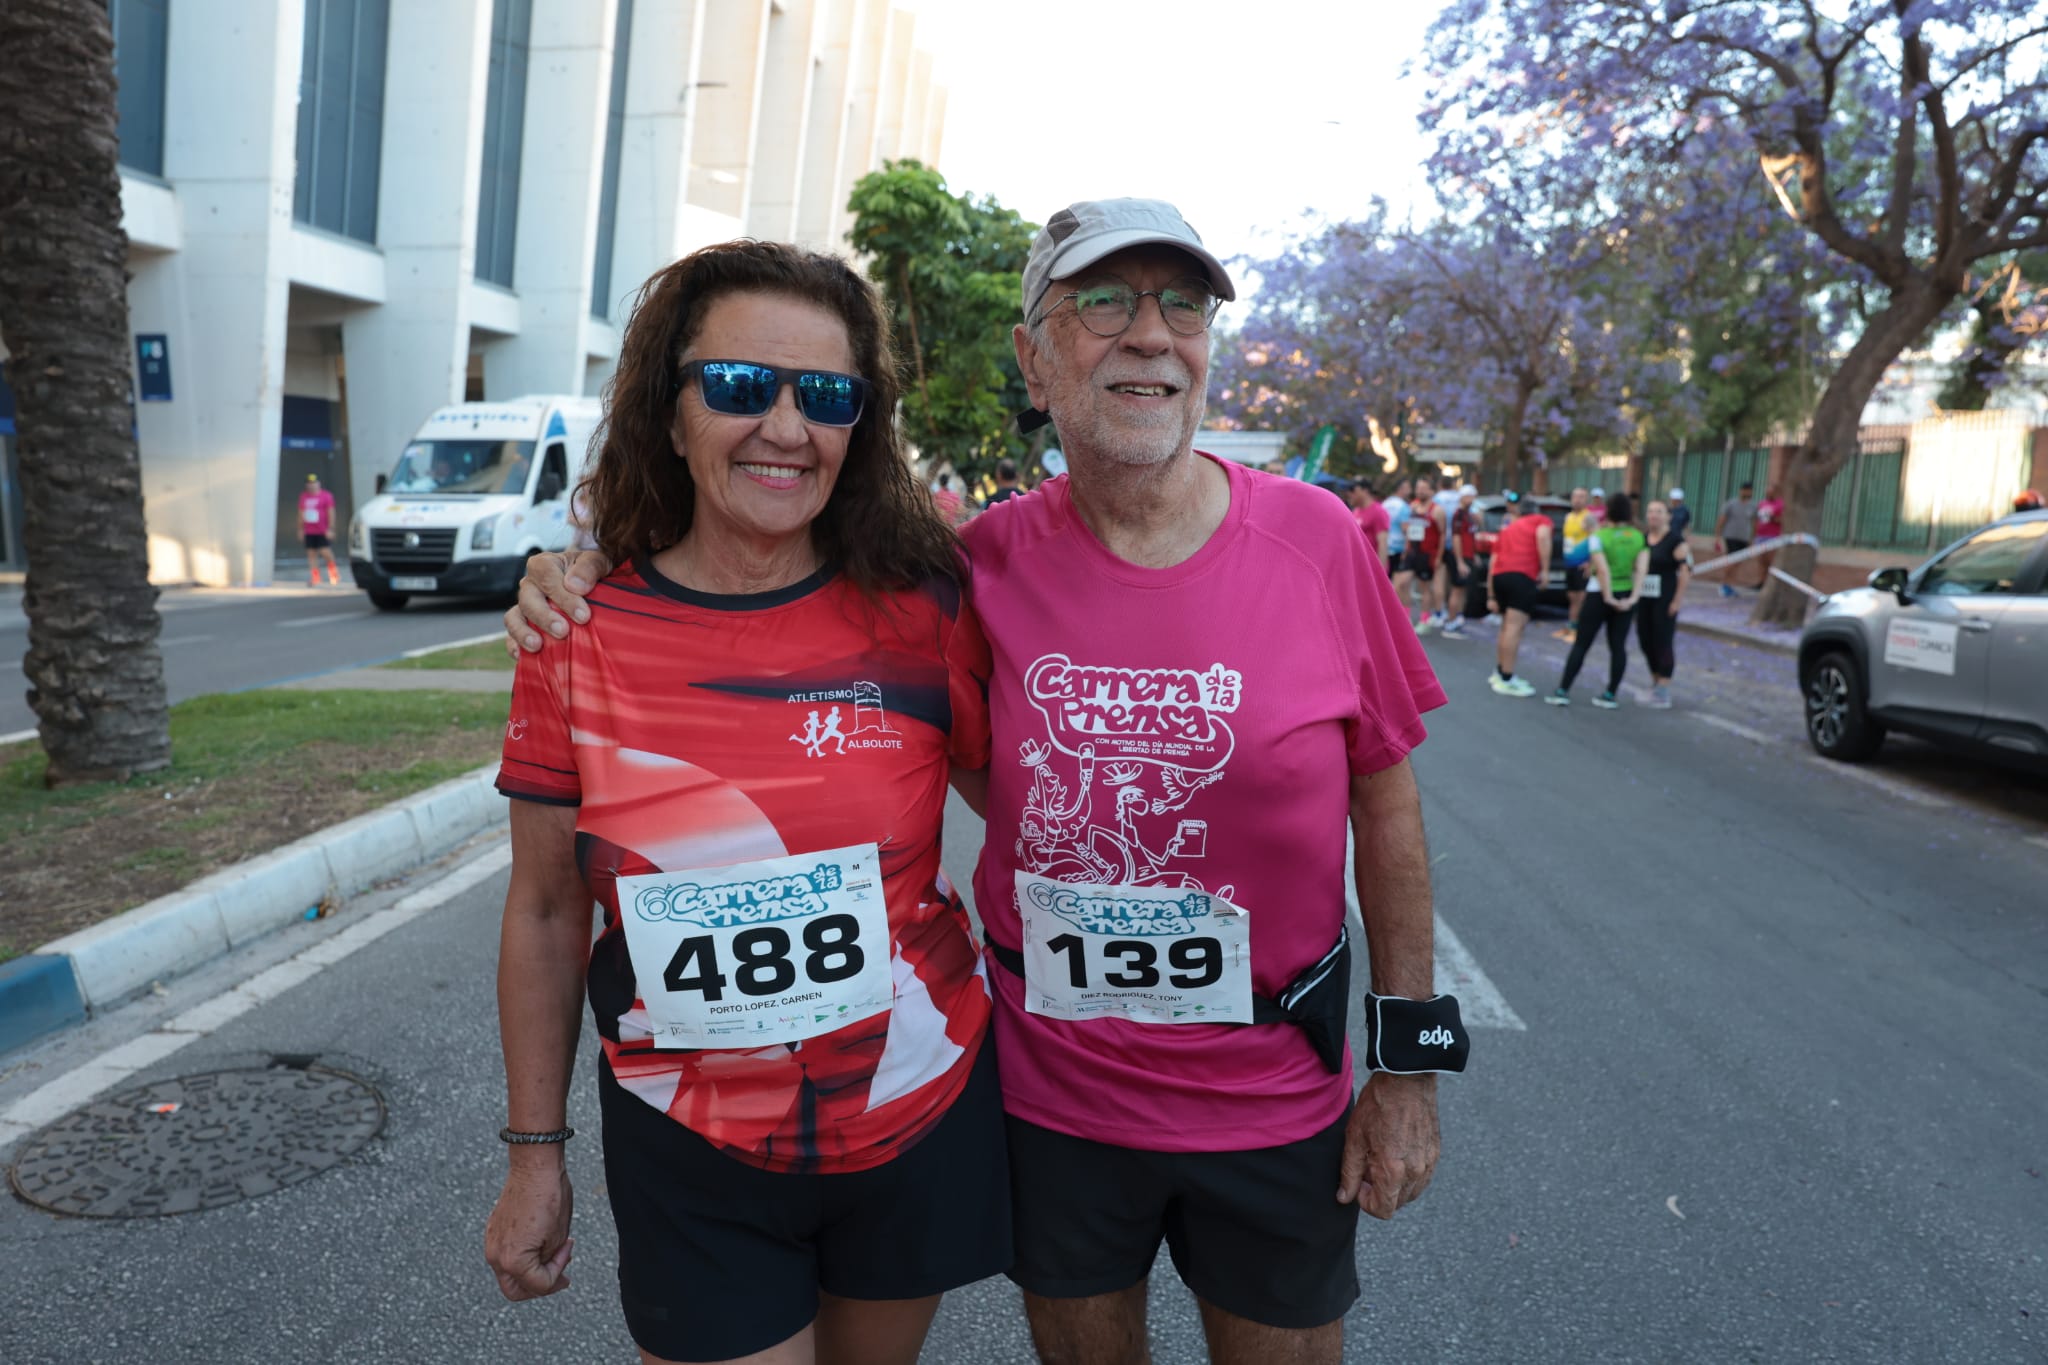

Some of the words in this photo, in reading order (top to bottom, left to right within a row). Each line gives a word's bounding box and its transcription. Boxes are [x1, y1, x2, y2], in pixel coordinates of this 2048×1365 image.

[1036, 665, 1201, 703] Carrera
[787, 689, 854, 704] ATLETISMO
[1060, 700, 1210, 740] Prensa
[847, 739, 903, 749] ALBOLOTE
[1095, 737, 1110, 745] CON
[1111, 738, 1136, 747] MOTIVO
[1137, 740, 1150, 748] DEL
[1165, 742, 1192, 750] MUNDIAL
[1118, 746, 1150, 754] LIBERTAD
[1152, 747, 1161, 755] DE
[1163, 748, 1190, 756] PRENSA
[852, 863, 860, 871] M
[671, 875, 812, 913] Carrera
[1056, 894, 1182, 918] Carrera
[663, 913, 864, 1002] 488
[1046, 933, 1223, 989] 139
[710, 1004, 743, 1015] PORTO
[745, 1000, 780, 1012] LOPEZ,
[781, 991, 823, 1006] CARNEN
[1081, 992, 1101, 1000] DIEZ
[1418, 1025, 1454, 1050] edp
